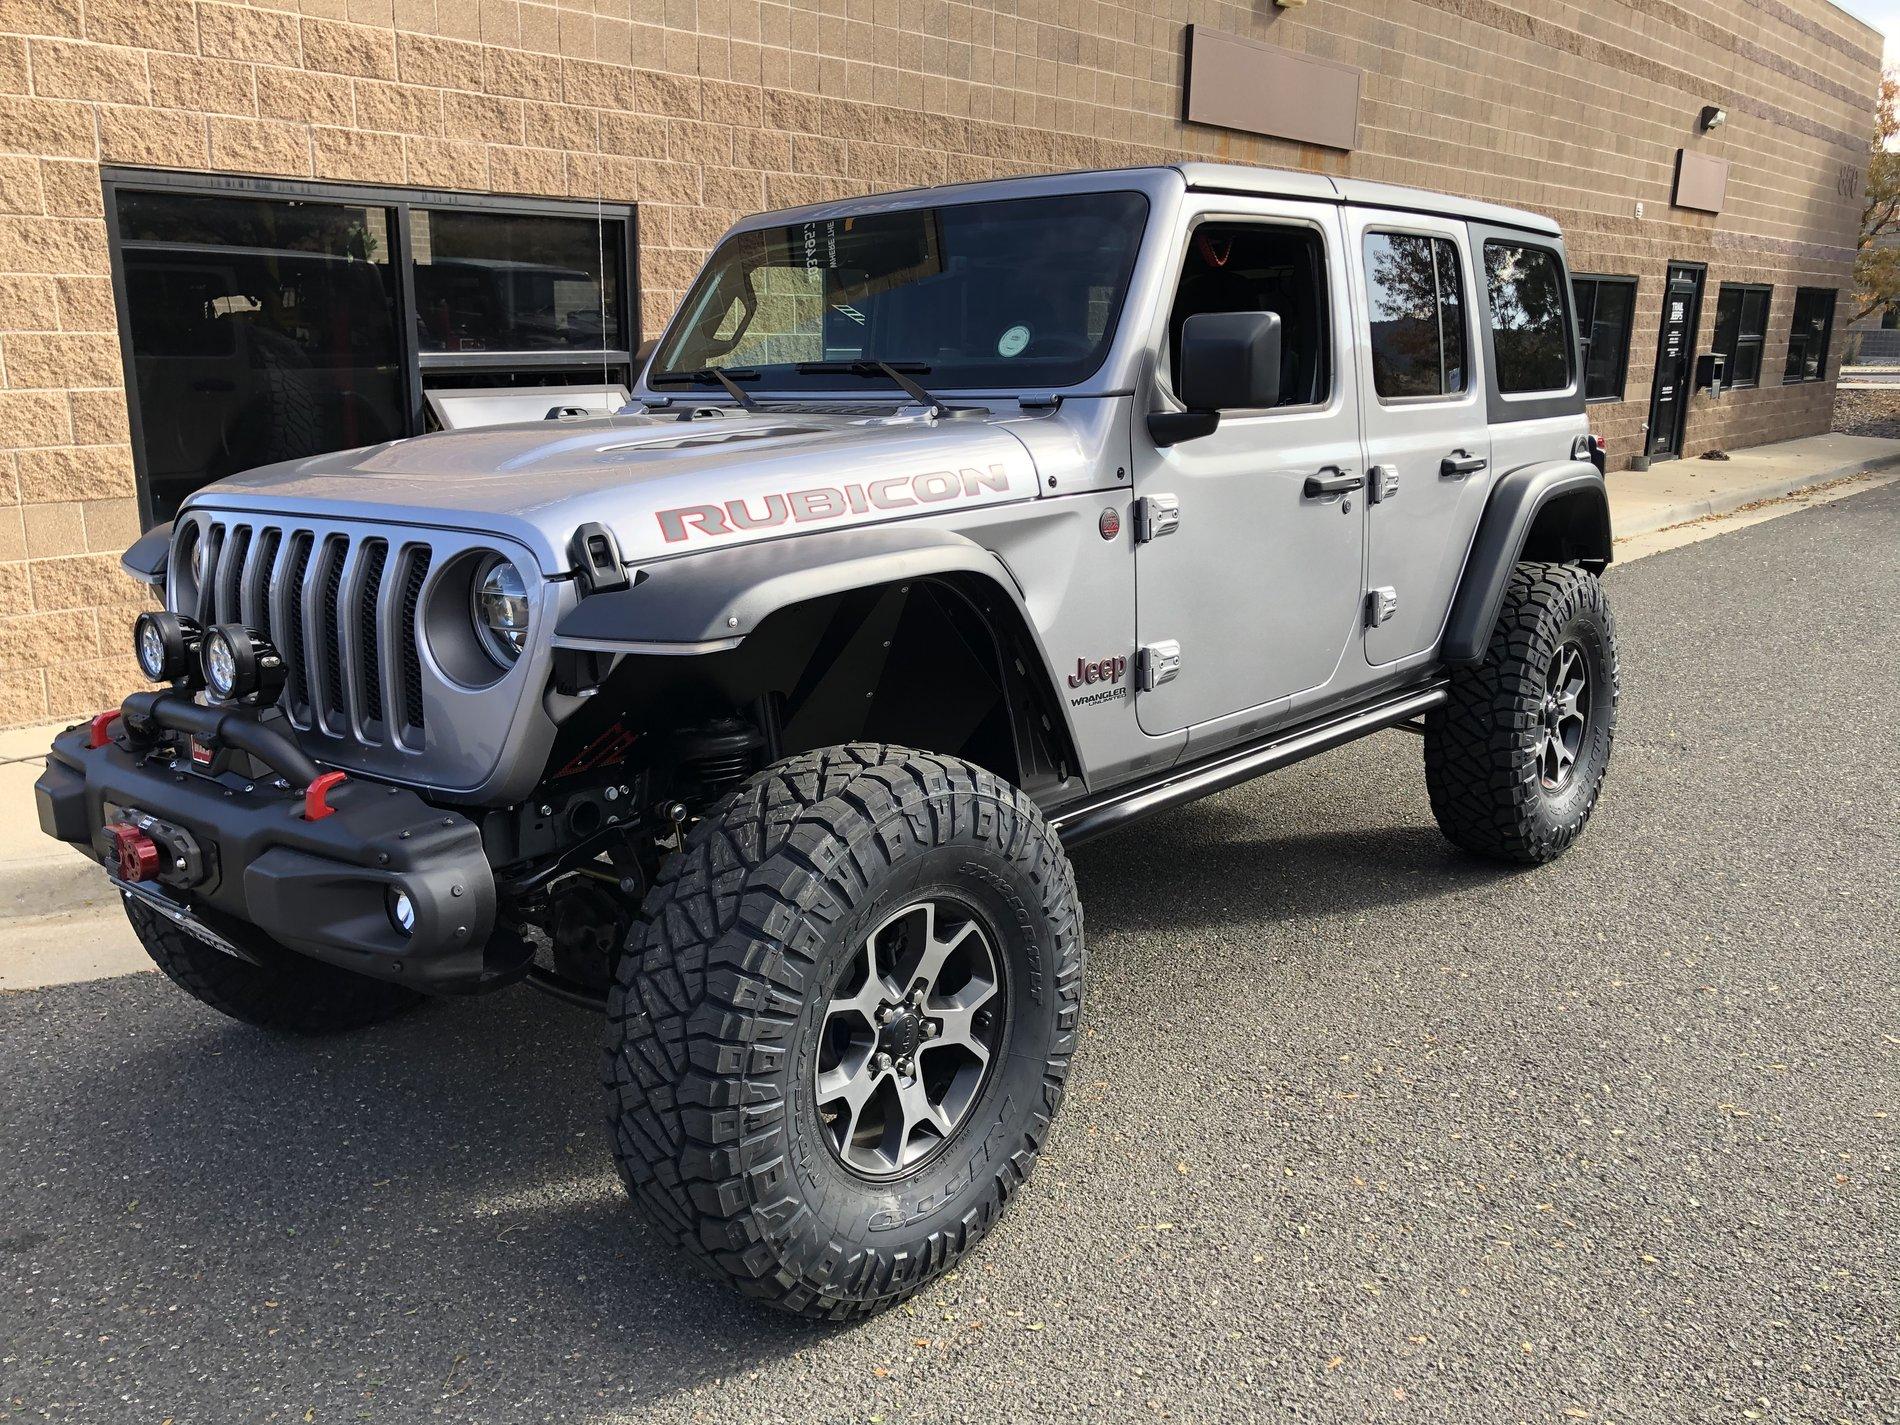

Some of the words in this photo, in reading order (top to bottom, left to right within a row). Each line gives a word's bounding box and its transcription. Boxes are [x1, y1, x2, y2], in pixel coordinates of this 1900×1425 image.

[655, 463, 1010, 543] RUBICON
[1068, 655, 1127, 688] Jeep
[1070, 687, 1127, 707] WRANGLER
[1088, 693, 1126, 706] UNLIMITED
